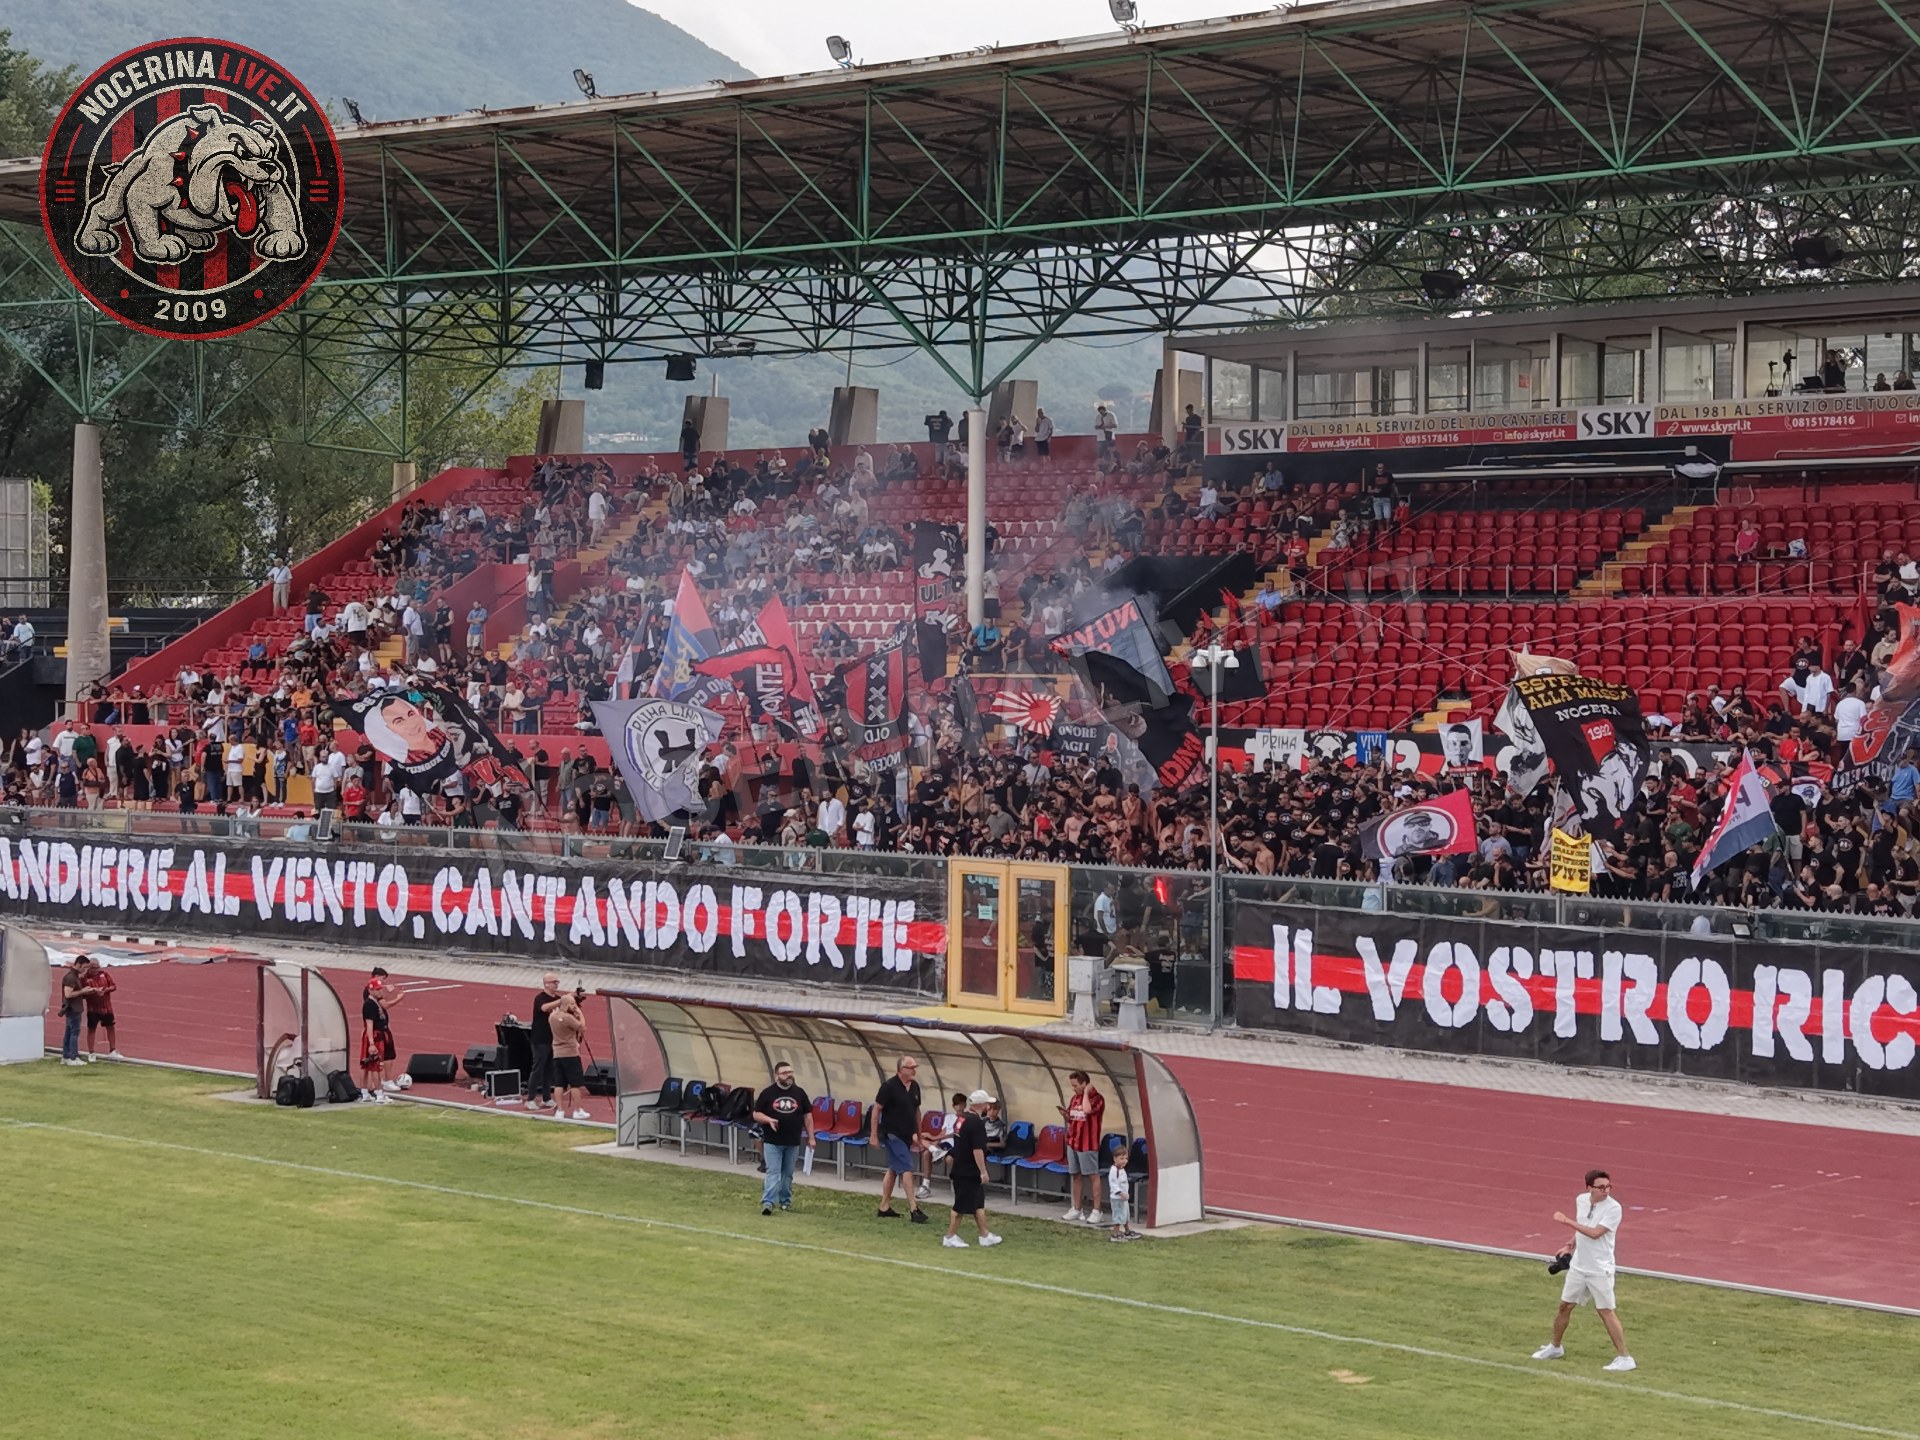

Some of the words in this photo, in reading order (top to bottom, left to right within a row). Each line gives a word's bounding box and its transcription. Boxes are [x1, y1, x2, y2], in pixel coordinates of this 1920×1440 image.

[1660, 406, 1688, 420] DAL
[1693, 405, 1727, 418] 1981
[1734, 404, 1752, 417] AL
[1757, 399, 1829, 416] SERVIZIO
[1834, 398, 1863, 412] DEL
[1868, 397, 1899, 411] TUO
[1291, 425, 1316, 436] DAL
[1321, 423, 1351, 435] 1981
[1356, 422, 1371, 434] AL
[1376, 419, 1436, 433] SERVIZIO
[1441, 418, 1464, 430] DEL
[1470, 416, 1496, 428] TUO
[1597, 410, 1651, 436] SKY
[1681, 420, 1752, 434] www.skysrl.it
[1792, 414, 1856, 428] 0815178416
[1238, 427, 1284, 451] SKY
[1311, 436, 1371, 449] www.skysrl.it
[1405, 432, 1459, 447] 0815178416
[1504, 427, 1566, 441] info@skysrl.it
[1529, 687, 1573, 710] ALLA
[1573, 686, 1633, 701] MASSA
[1555, 704, 1622, 722] NOCERA
[1058, 725, 1098, 739] ONORE
[1261, 734, 1297, 750] PRIMA
[1552, 863, 1589, 882] VIVE
[180, 849, 240, 916] AL
[432, 866, 718, 953] CANTANDO
[731, 884, 916, 972] FORTE
[1272, 923, 1342, 1014] IL
[1355, 935, 1731, 1051] VOSTRO
[1752, 964, 1918, 1070] RIC
